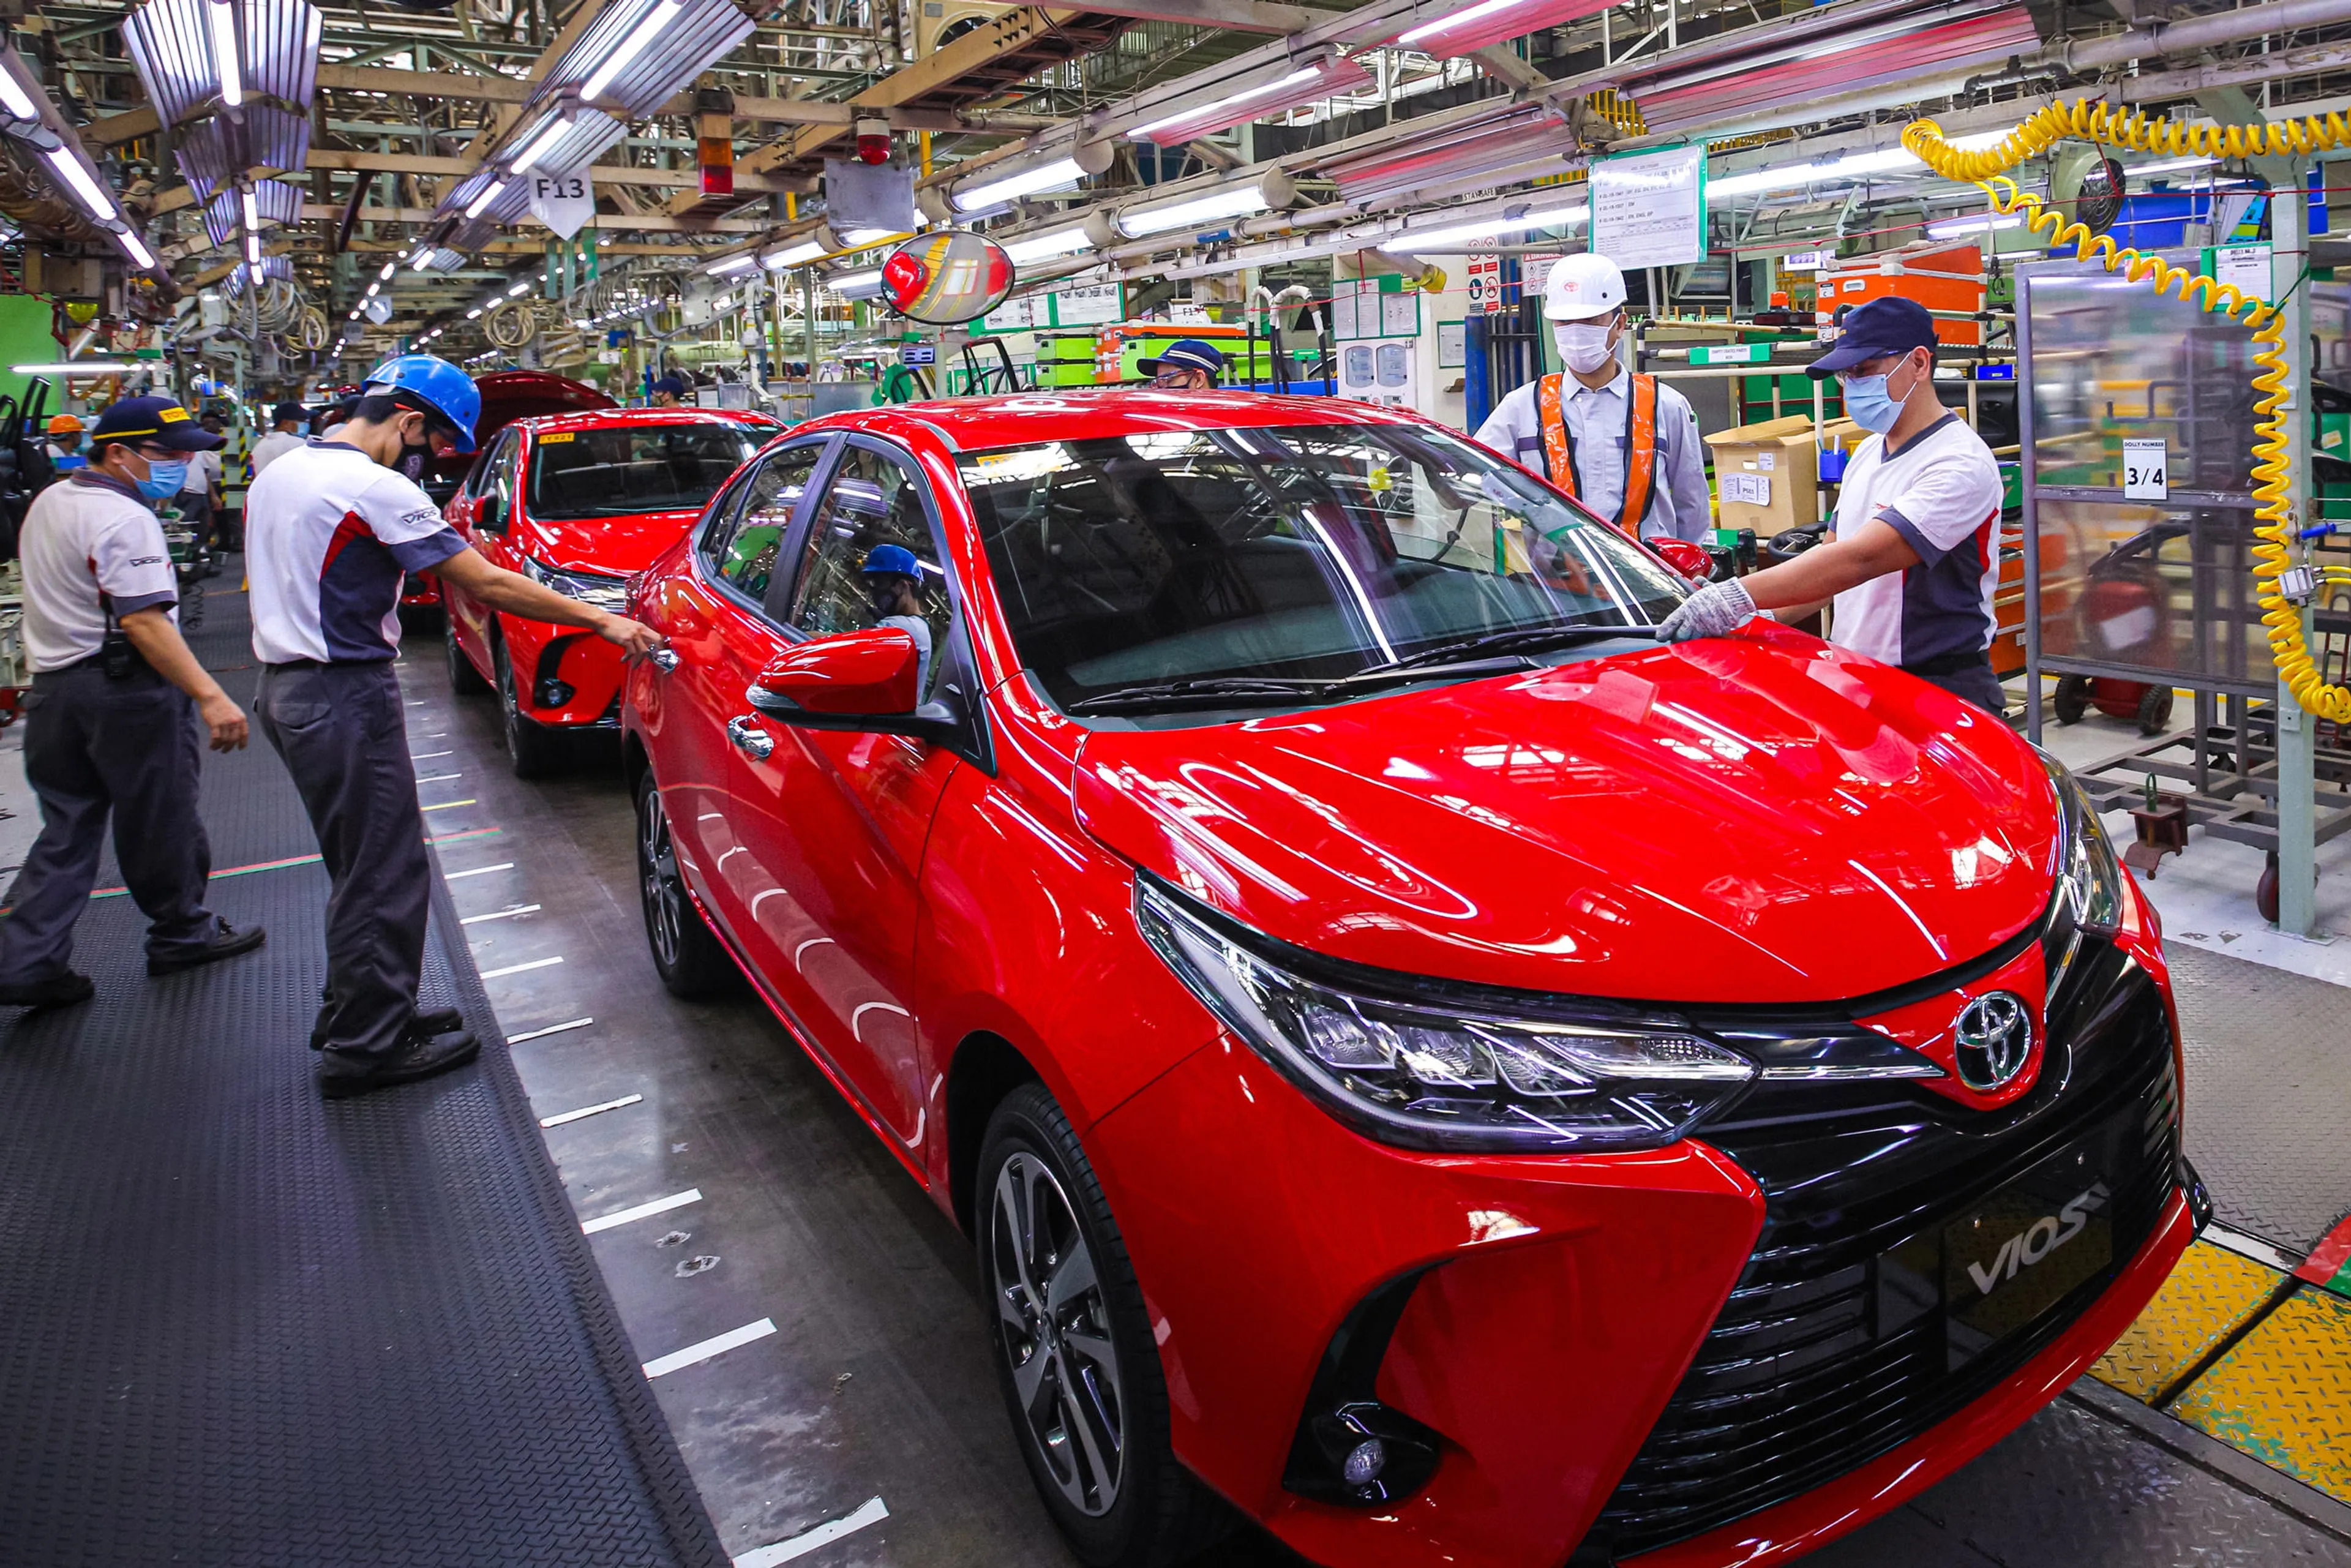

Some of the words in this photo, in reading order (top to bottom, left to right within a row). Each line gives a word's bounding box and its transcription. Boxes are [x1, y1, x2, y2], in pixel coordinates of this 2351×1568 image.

[536, 178, 585, 199] F13
[402, 508, 437, 523] VIOS
[1967, 1181, 2111, 1295] VIOS
